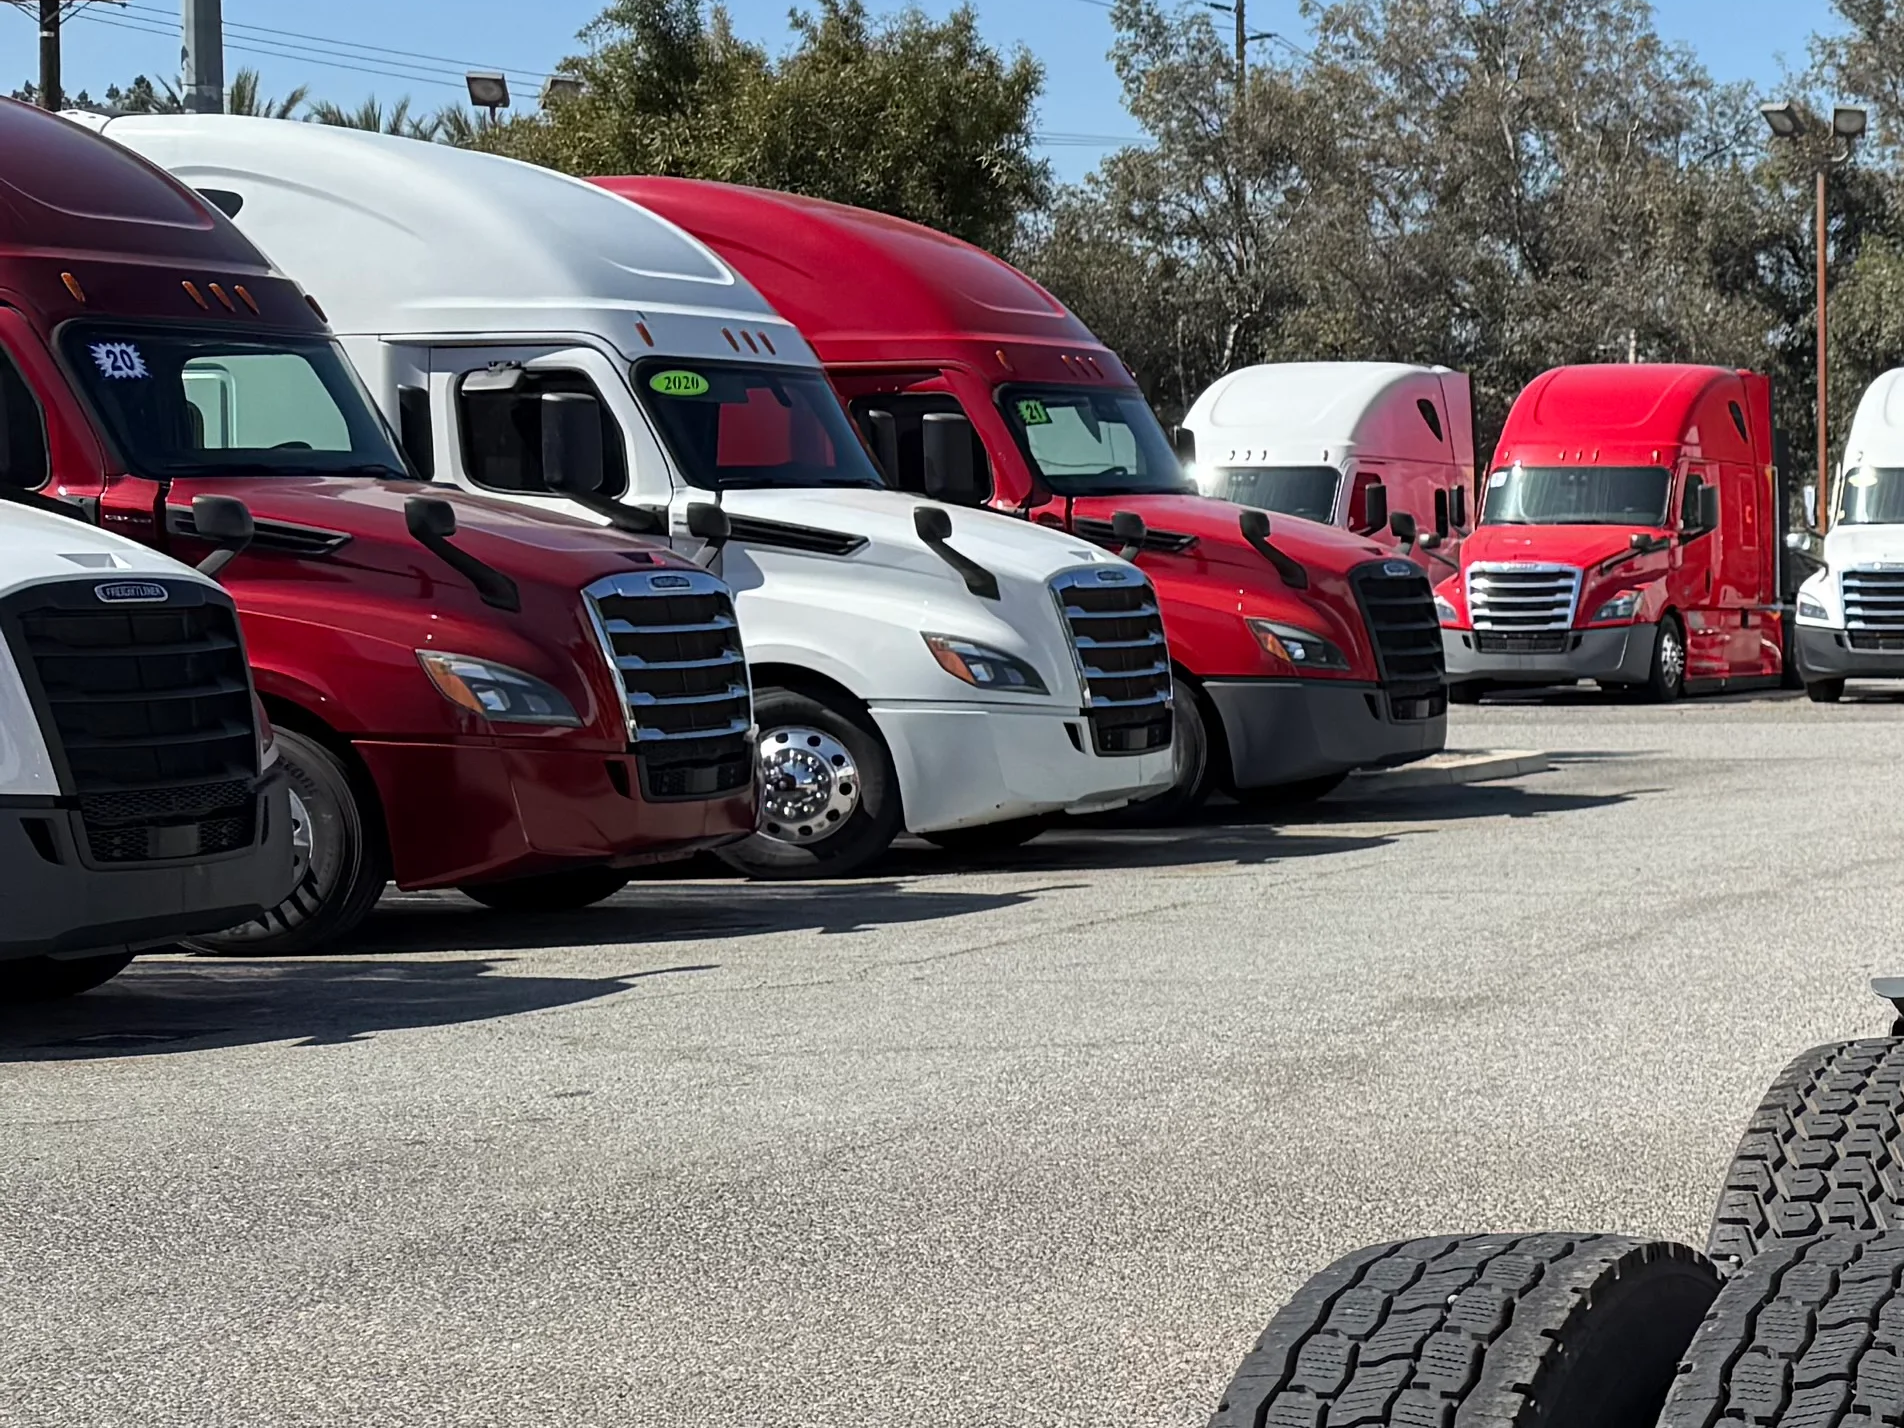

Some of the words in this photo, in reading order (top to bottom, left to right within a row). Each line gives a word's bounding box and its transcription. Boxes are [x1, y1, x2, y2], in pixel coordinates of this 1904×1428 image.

[105, 349, 135, 372] 20
[663, 375, 700, 391] 2020
[1025, 403, 1044, 420] 21
